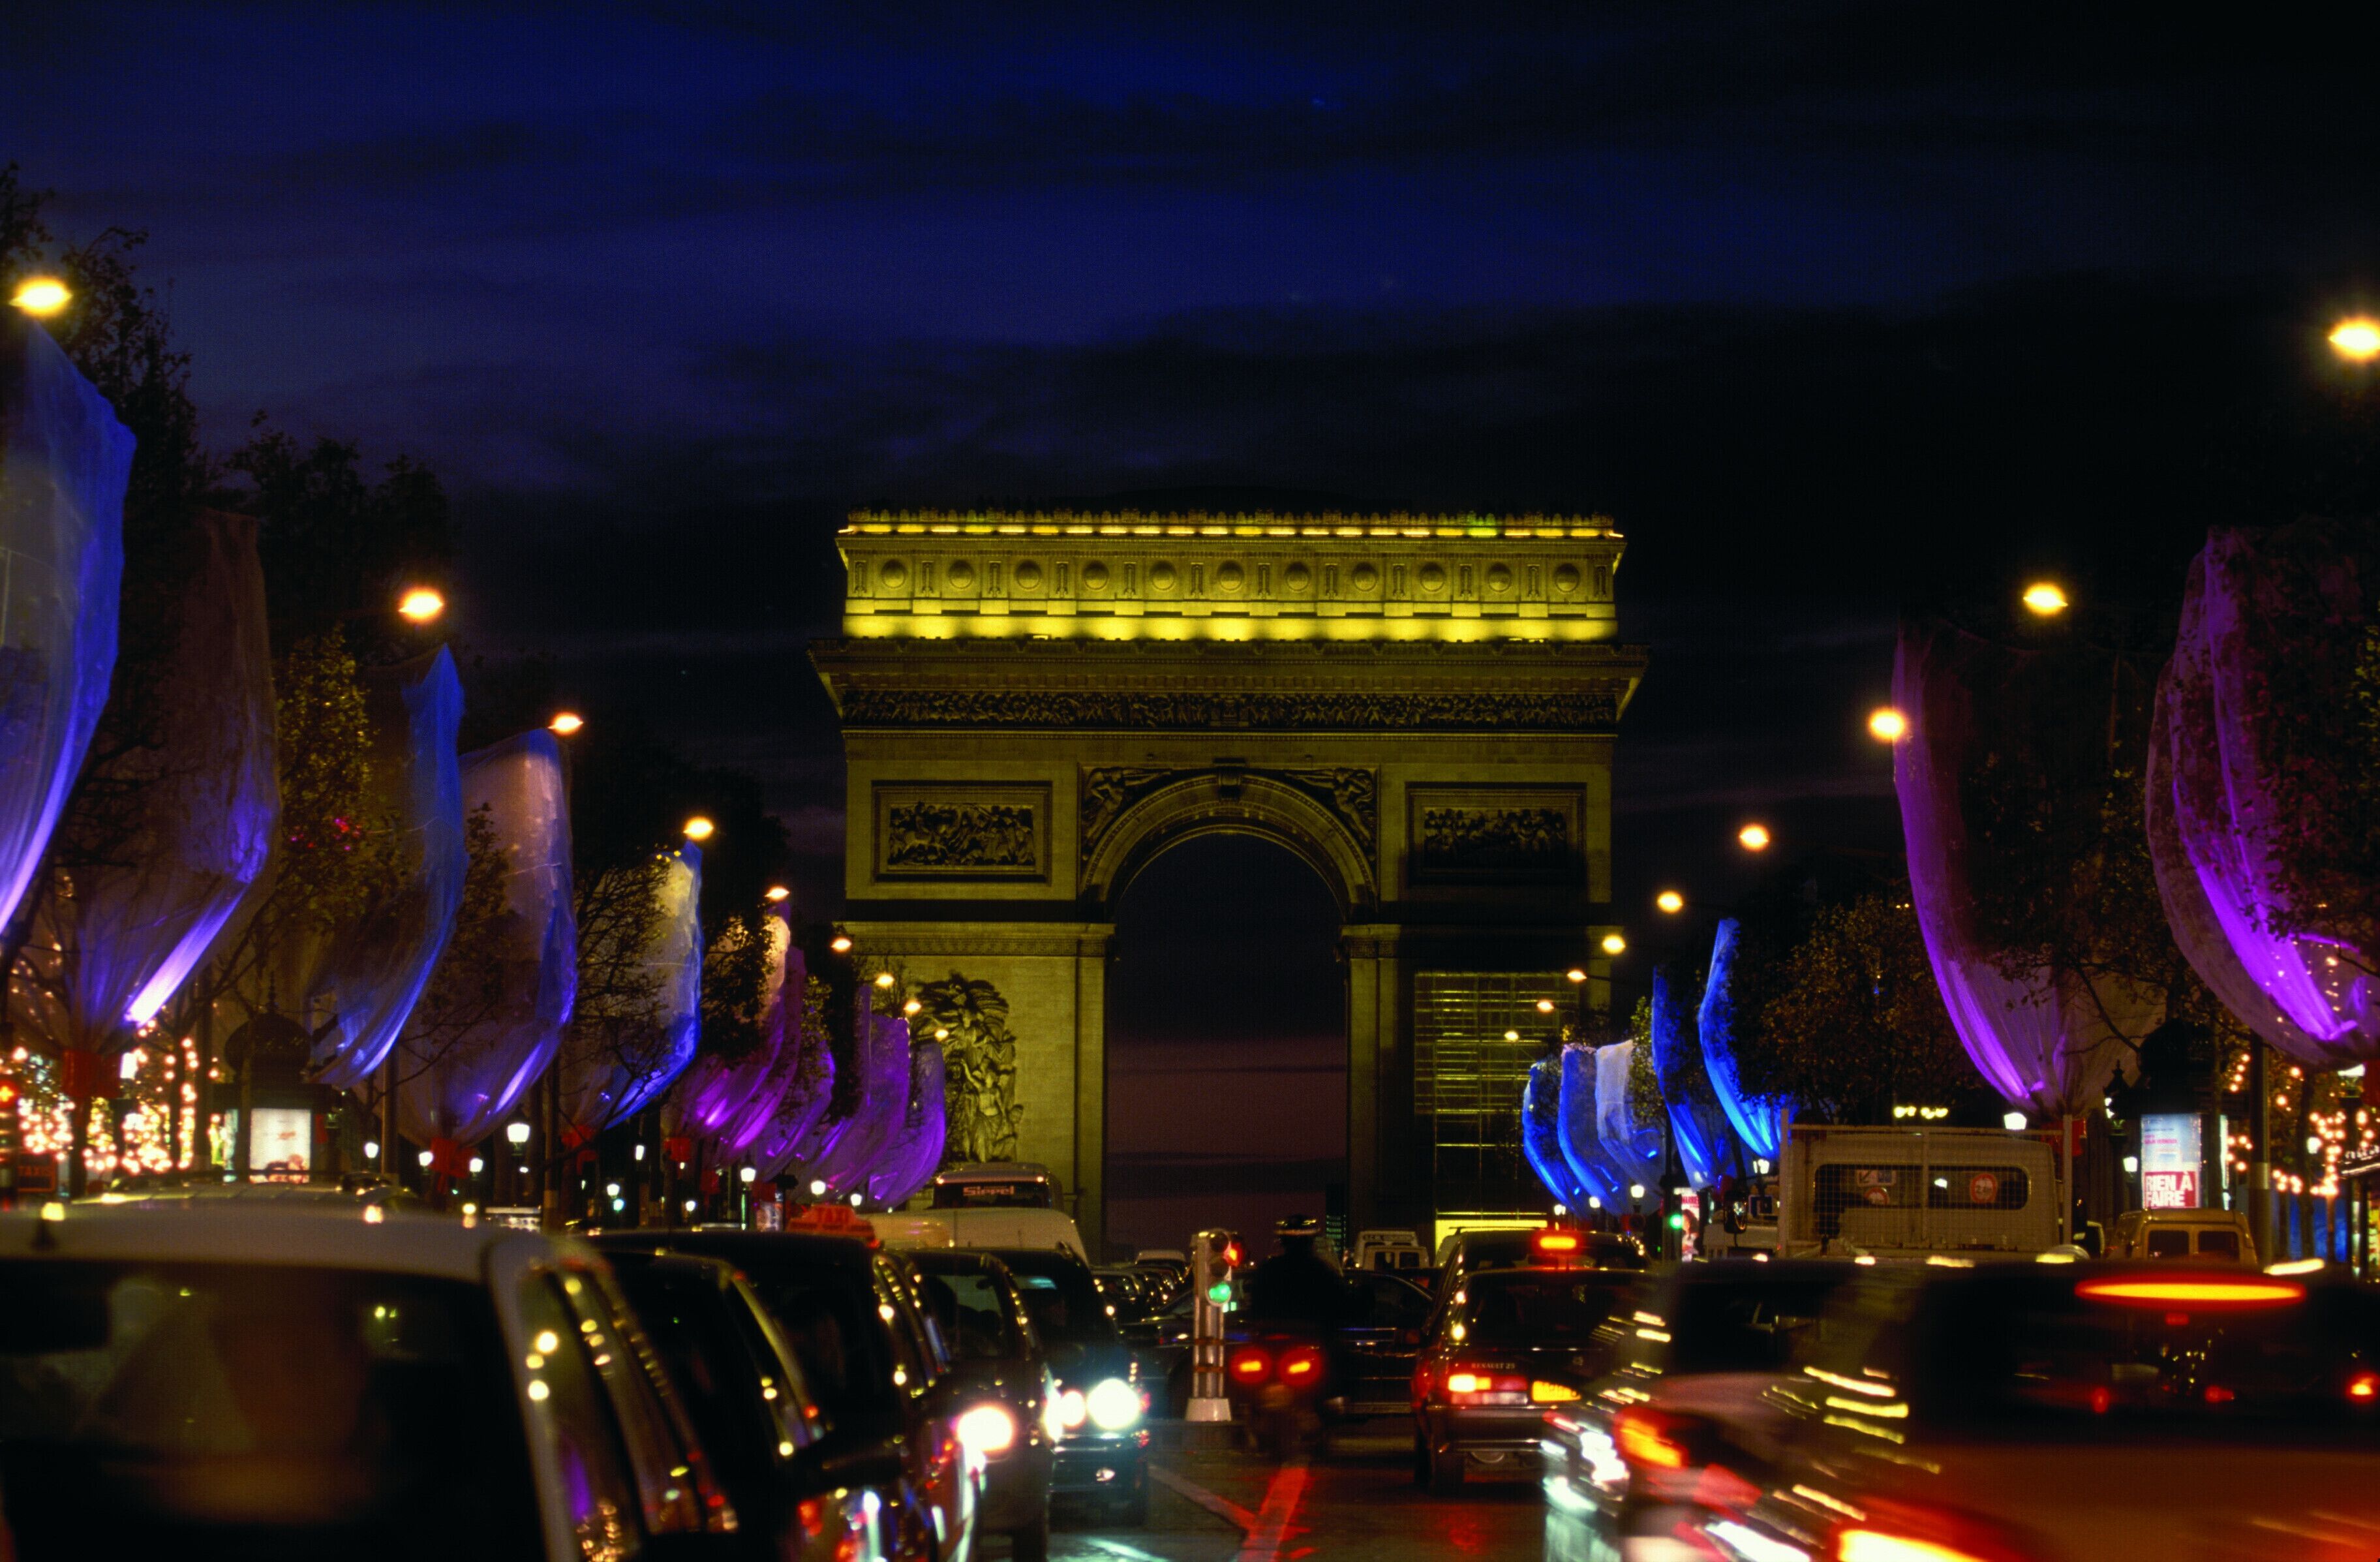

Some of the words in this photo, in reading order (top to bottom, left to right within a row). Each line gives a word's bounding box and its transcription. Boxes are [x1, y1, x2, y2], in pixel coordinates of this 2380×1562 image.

[2145, 1175, 2176, 1191] RIEN
[2180, 1171, 2193, 1191] À
[2145, 1191, 2186, 1207] FAIRE
[816, 1206, 849, 1223] TAXI
